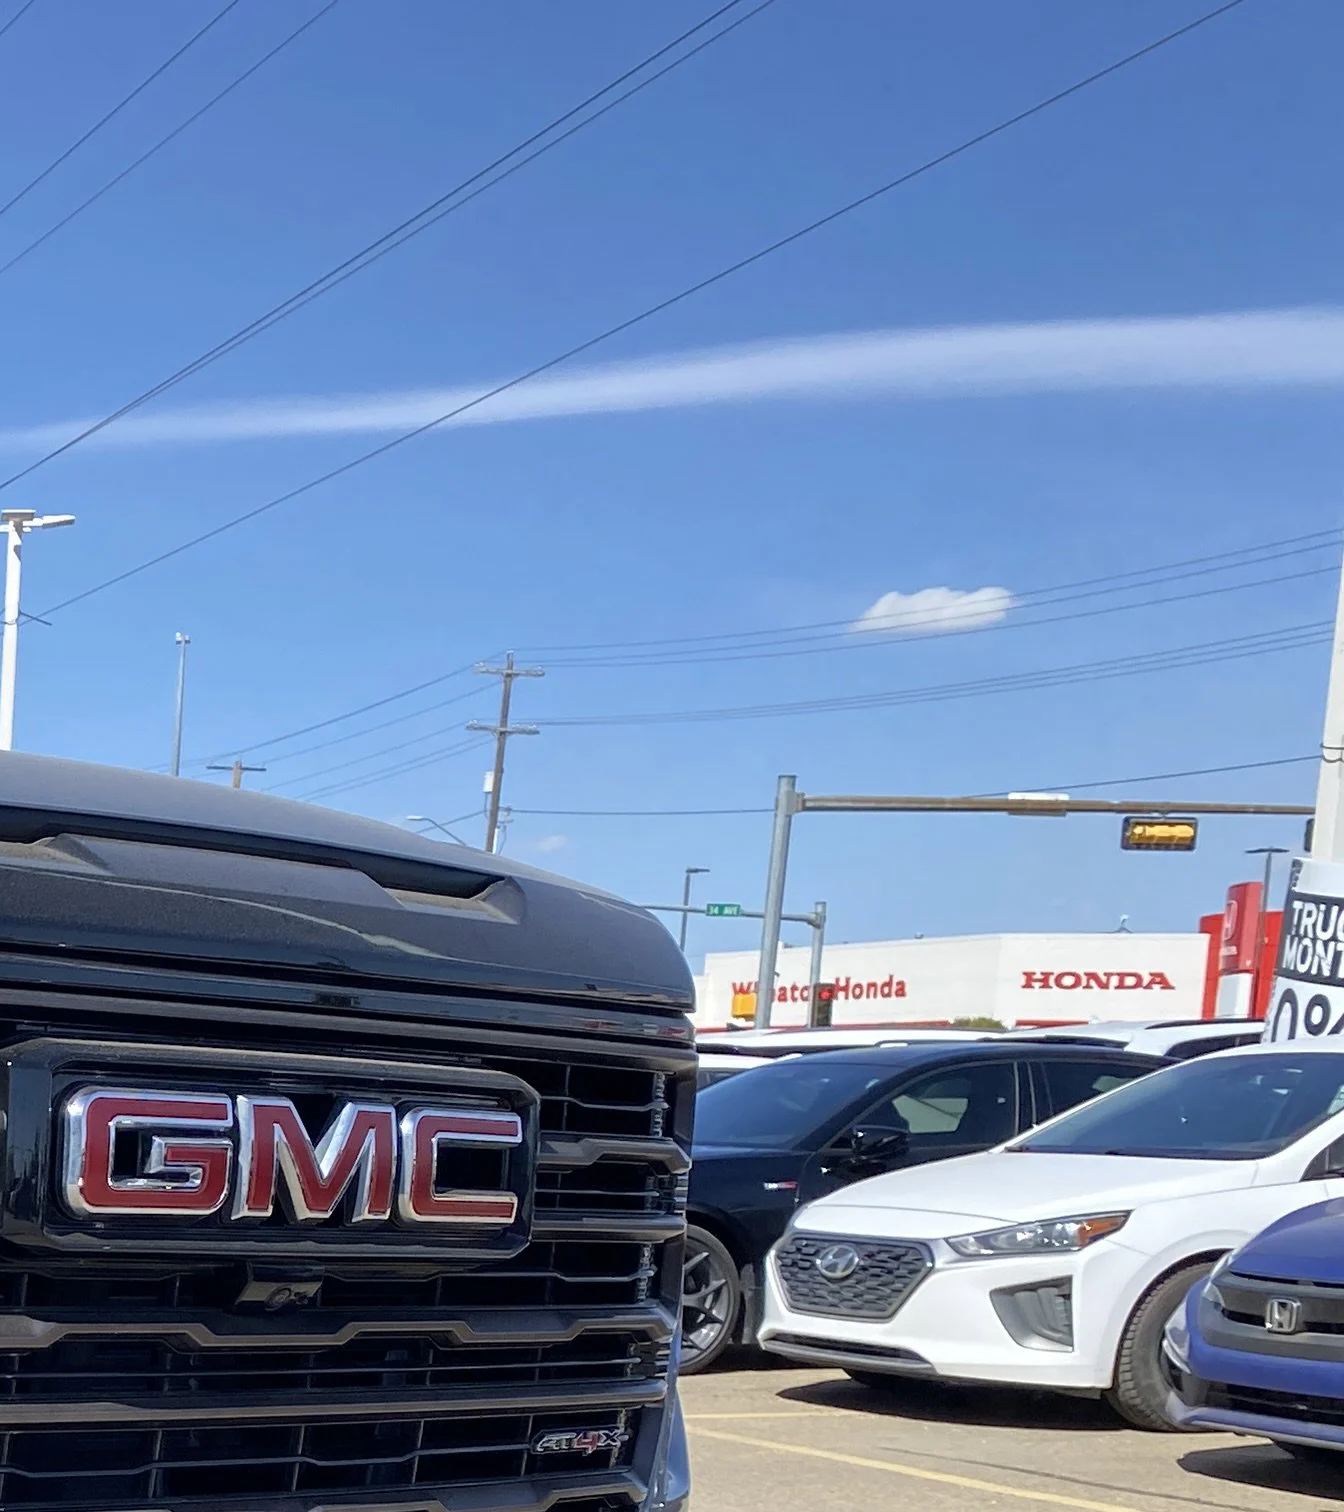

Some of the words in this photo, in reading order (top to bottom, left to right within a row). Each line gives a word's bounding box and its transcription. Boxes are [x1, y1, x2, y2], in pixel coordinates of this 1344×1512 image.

[834, 974, 907, 1001] Honda
[1021, 971, 1176, 990] HONDA
[64, 1087, 522, 1224] GMC
[536, 1428, 625, 1455] AT4X
